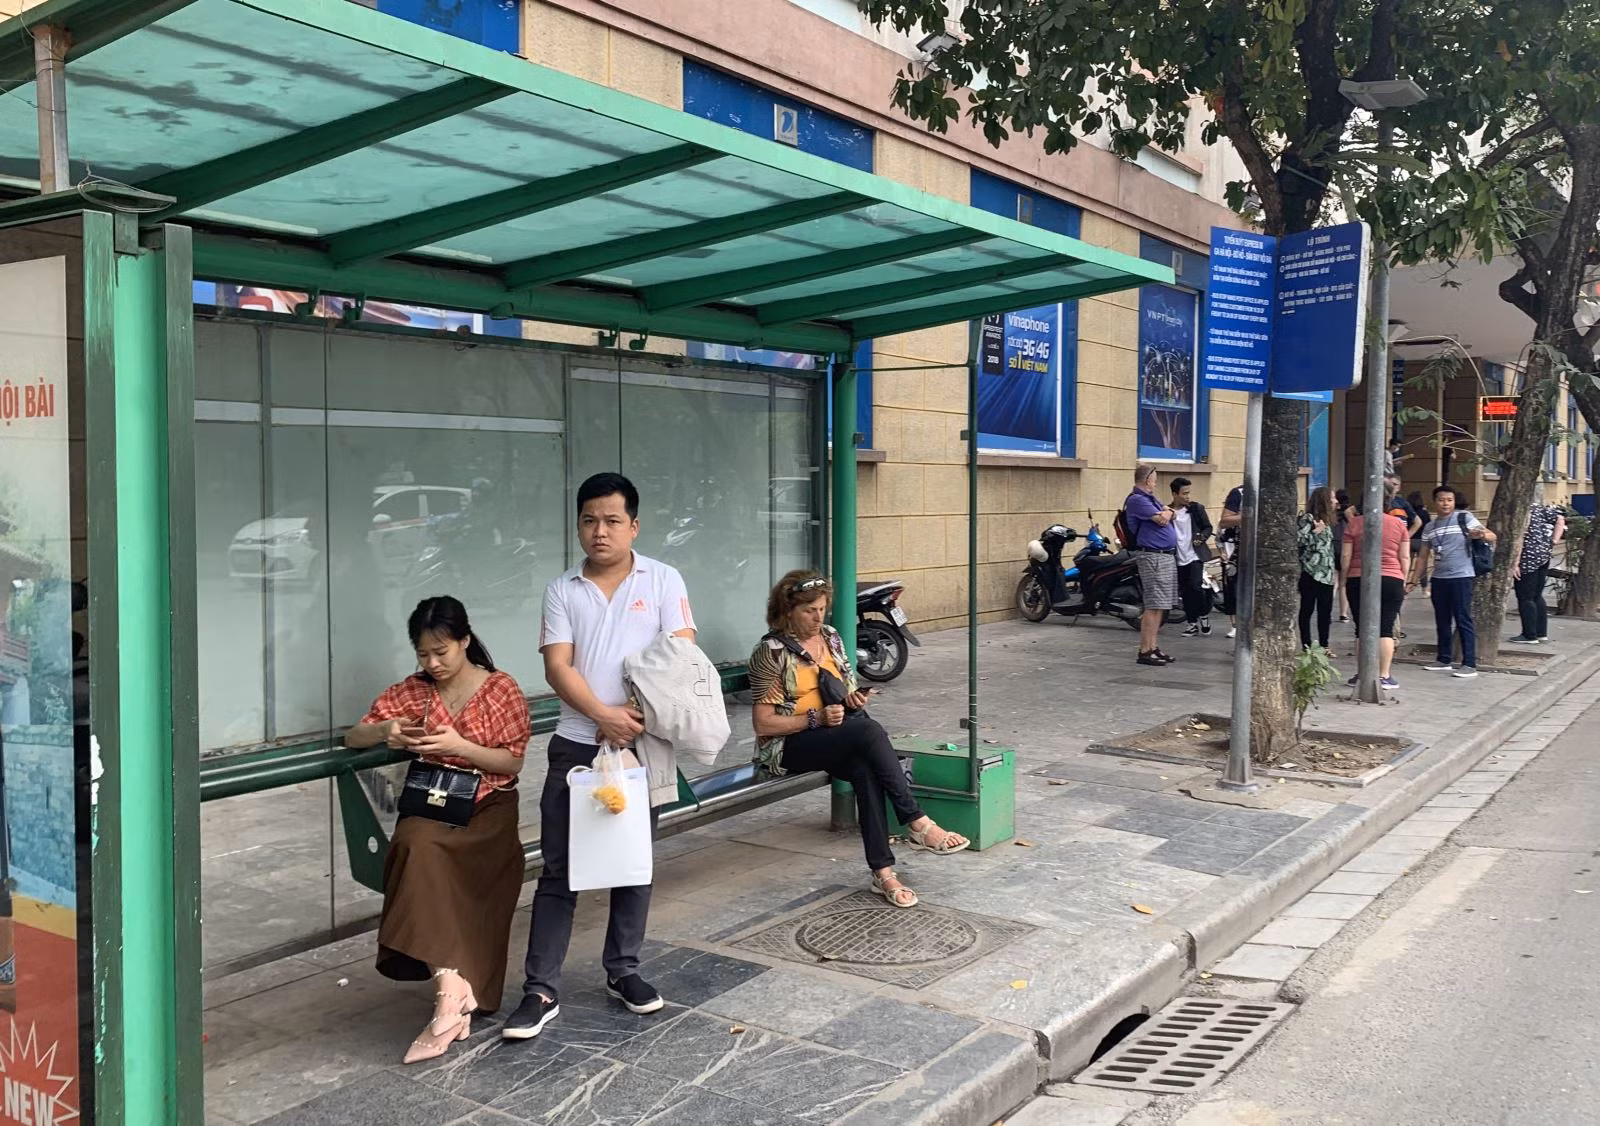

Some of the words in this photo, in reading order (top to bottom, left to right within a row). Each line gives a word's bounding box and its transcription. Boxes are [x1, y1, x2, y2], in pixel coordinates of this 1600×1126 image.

[1008, 312, 1050, 333] vinaphone
[0, 379, 19, 427] ỘI
[25, 377, 54, 418] BÀI
[4, 1077, 55, 1126] NEW
